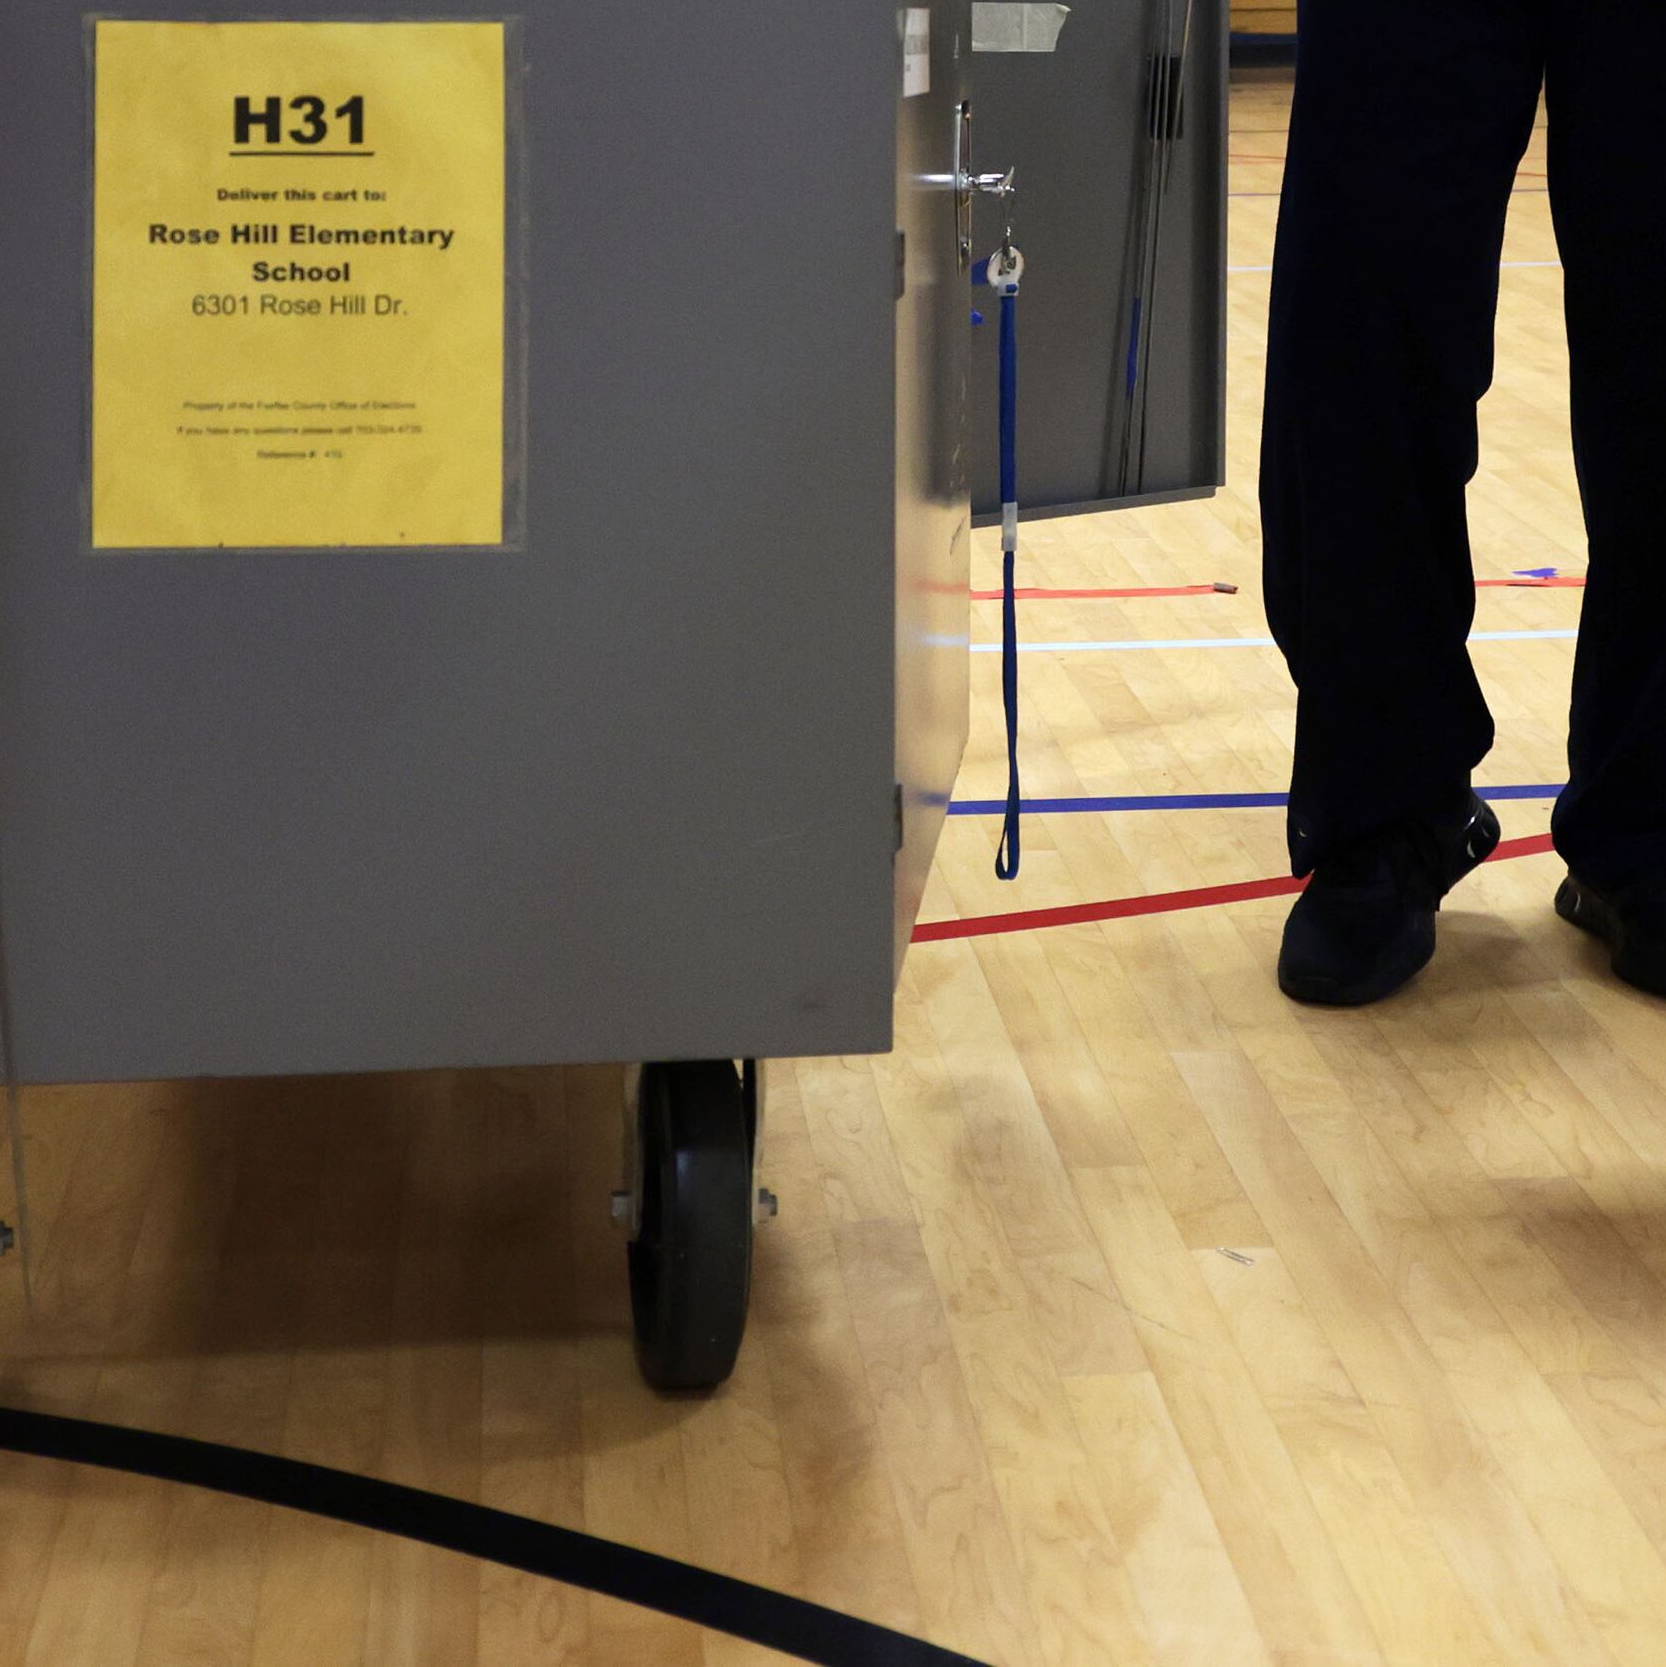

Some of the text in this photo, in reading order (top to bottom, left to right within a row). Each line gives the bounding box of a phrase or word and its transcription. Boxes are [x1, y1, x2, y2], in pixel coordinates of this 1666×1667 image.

[233, 95, 365, 146] H31
[217, 189, 278, 202] Deliver
[284, 188, 316, 201] this
[322, 189, 357, 201] cart
[149, 223, 455, 250] Rose Hill Elementary
[251, 261, 351, 283] School
[192, 294, 408, 317] 6301 Rose Hill Dr.
